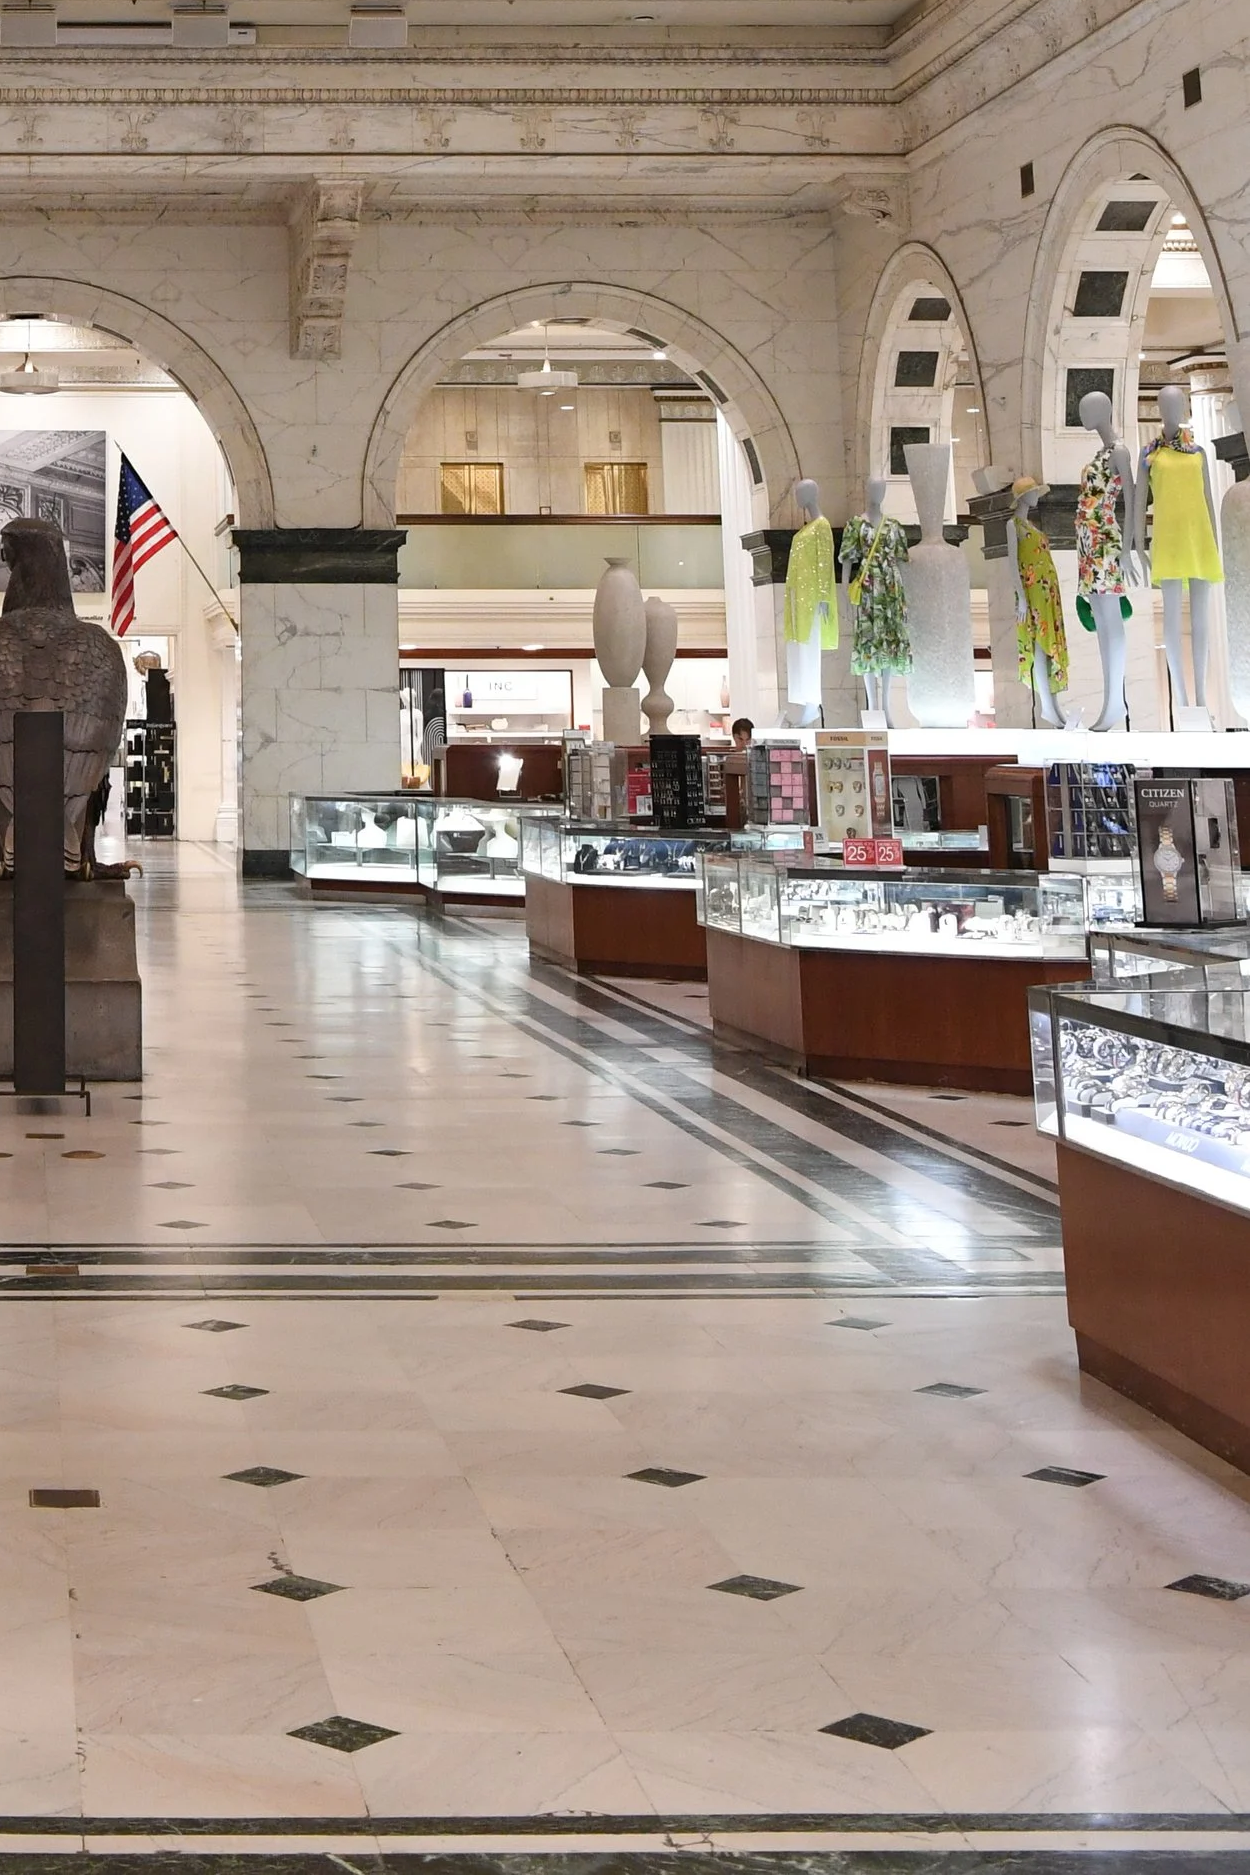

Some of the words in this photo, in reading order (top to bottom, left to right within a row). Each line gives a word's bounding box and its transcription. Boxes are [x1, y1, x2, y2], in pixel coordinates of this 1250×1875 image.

[489, 681, 512, 691] INC
[1141, 788, 1185, 798] CITIZEN
[1149, 800, 1178, 808] QUARTZ
[847, 846, 867, 861] 25
[878, 846, 894, 862] 25
